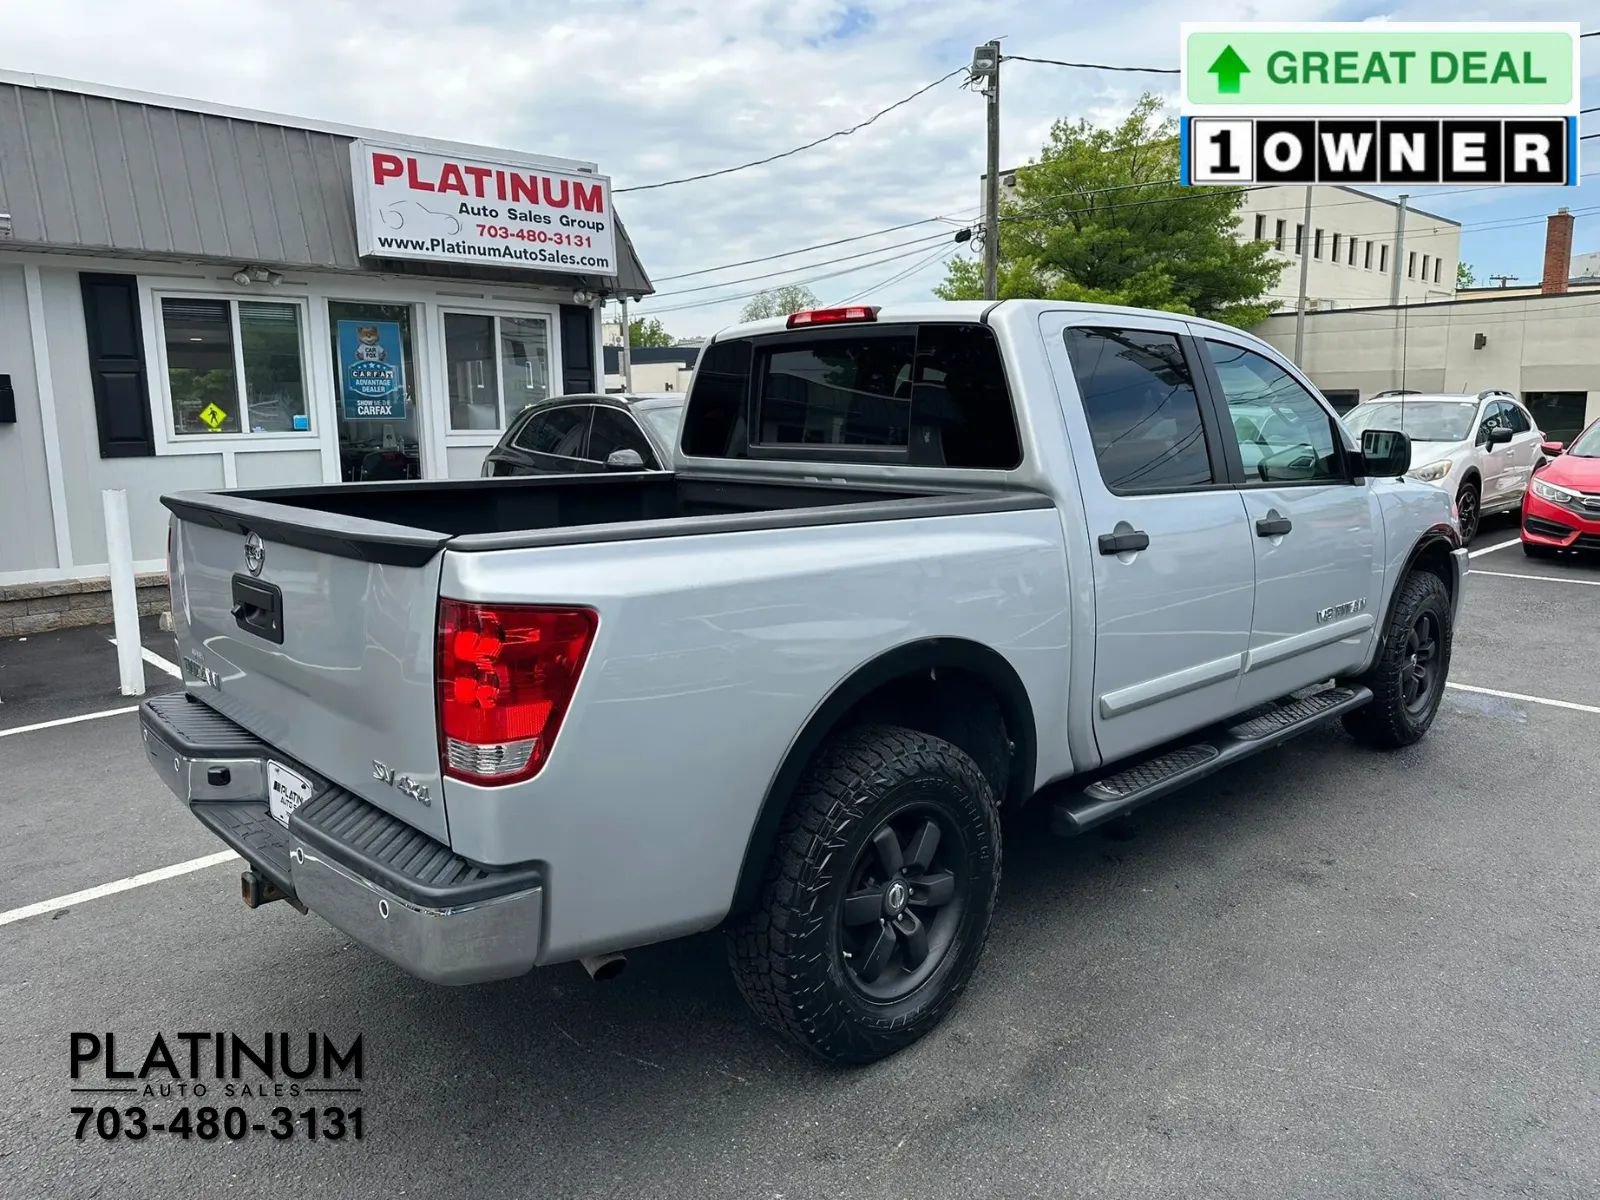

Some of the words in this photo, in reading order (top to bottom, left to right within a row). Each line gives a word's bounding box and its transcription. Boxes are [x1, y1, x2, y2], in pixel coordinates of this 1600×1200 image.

[372, 152, 604, 214] PLATINUM
[458, 202, 499, 219] Auto
[507, 208, 552, 225] Sales
[559, 214, 605, 233] Group
[476, 224, 592, 248] 703-480-3131
[378, 236, 609, 268] www.PlatinumAutoSales.com
[352, 370, 394, 378] CARFAX
[357, 406, 392, 415] CARFAX
[372, 759, 395, 787] SV
